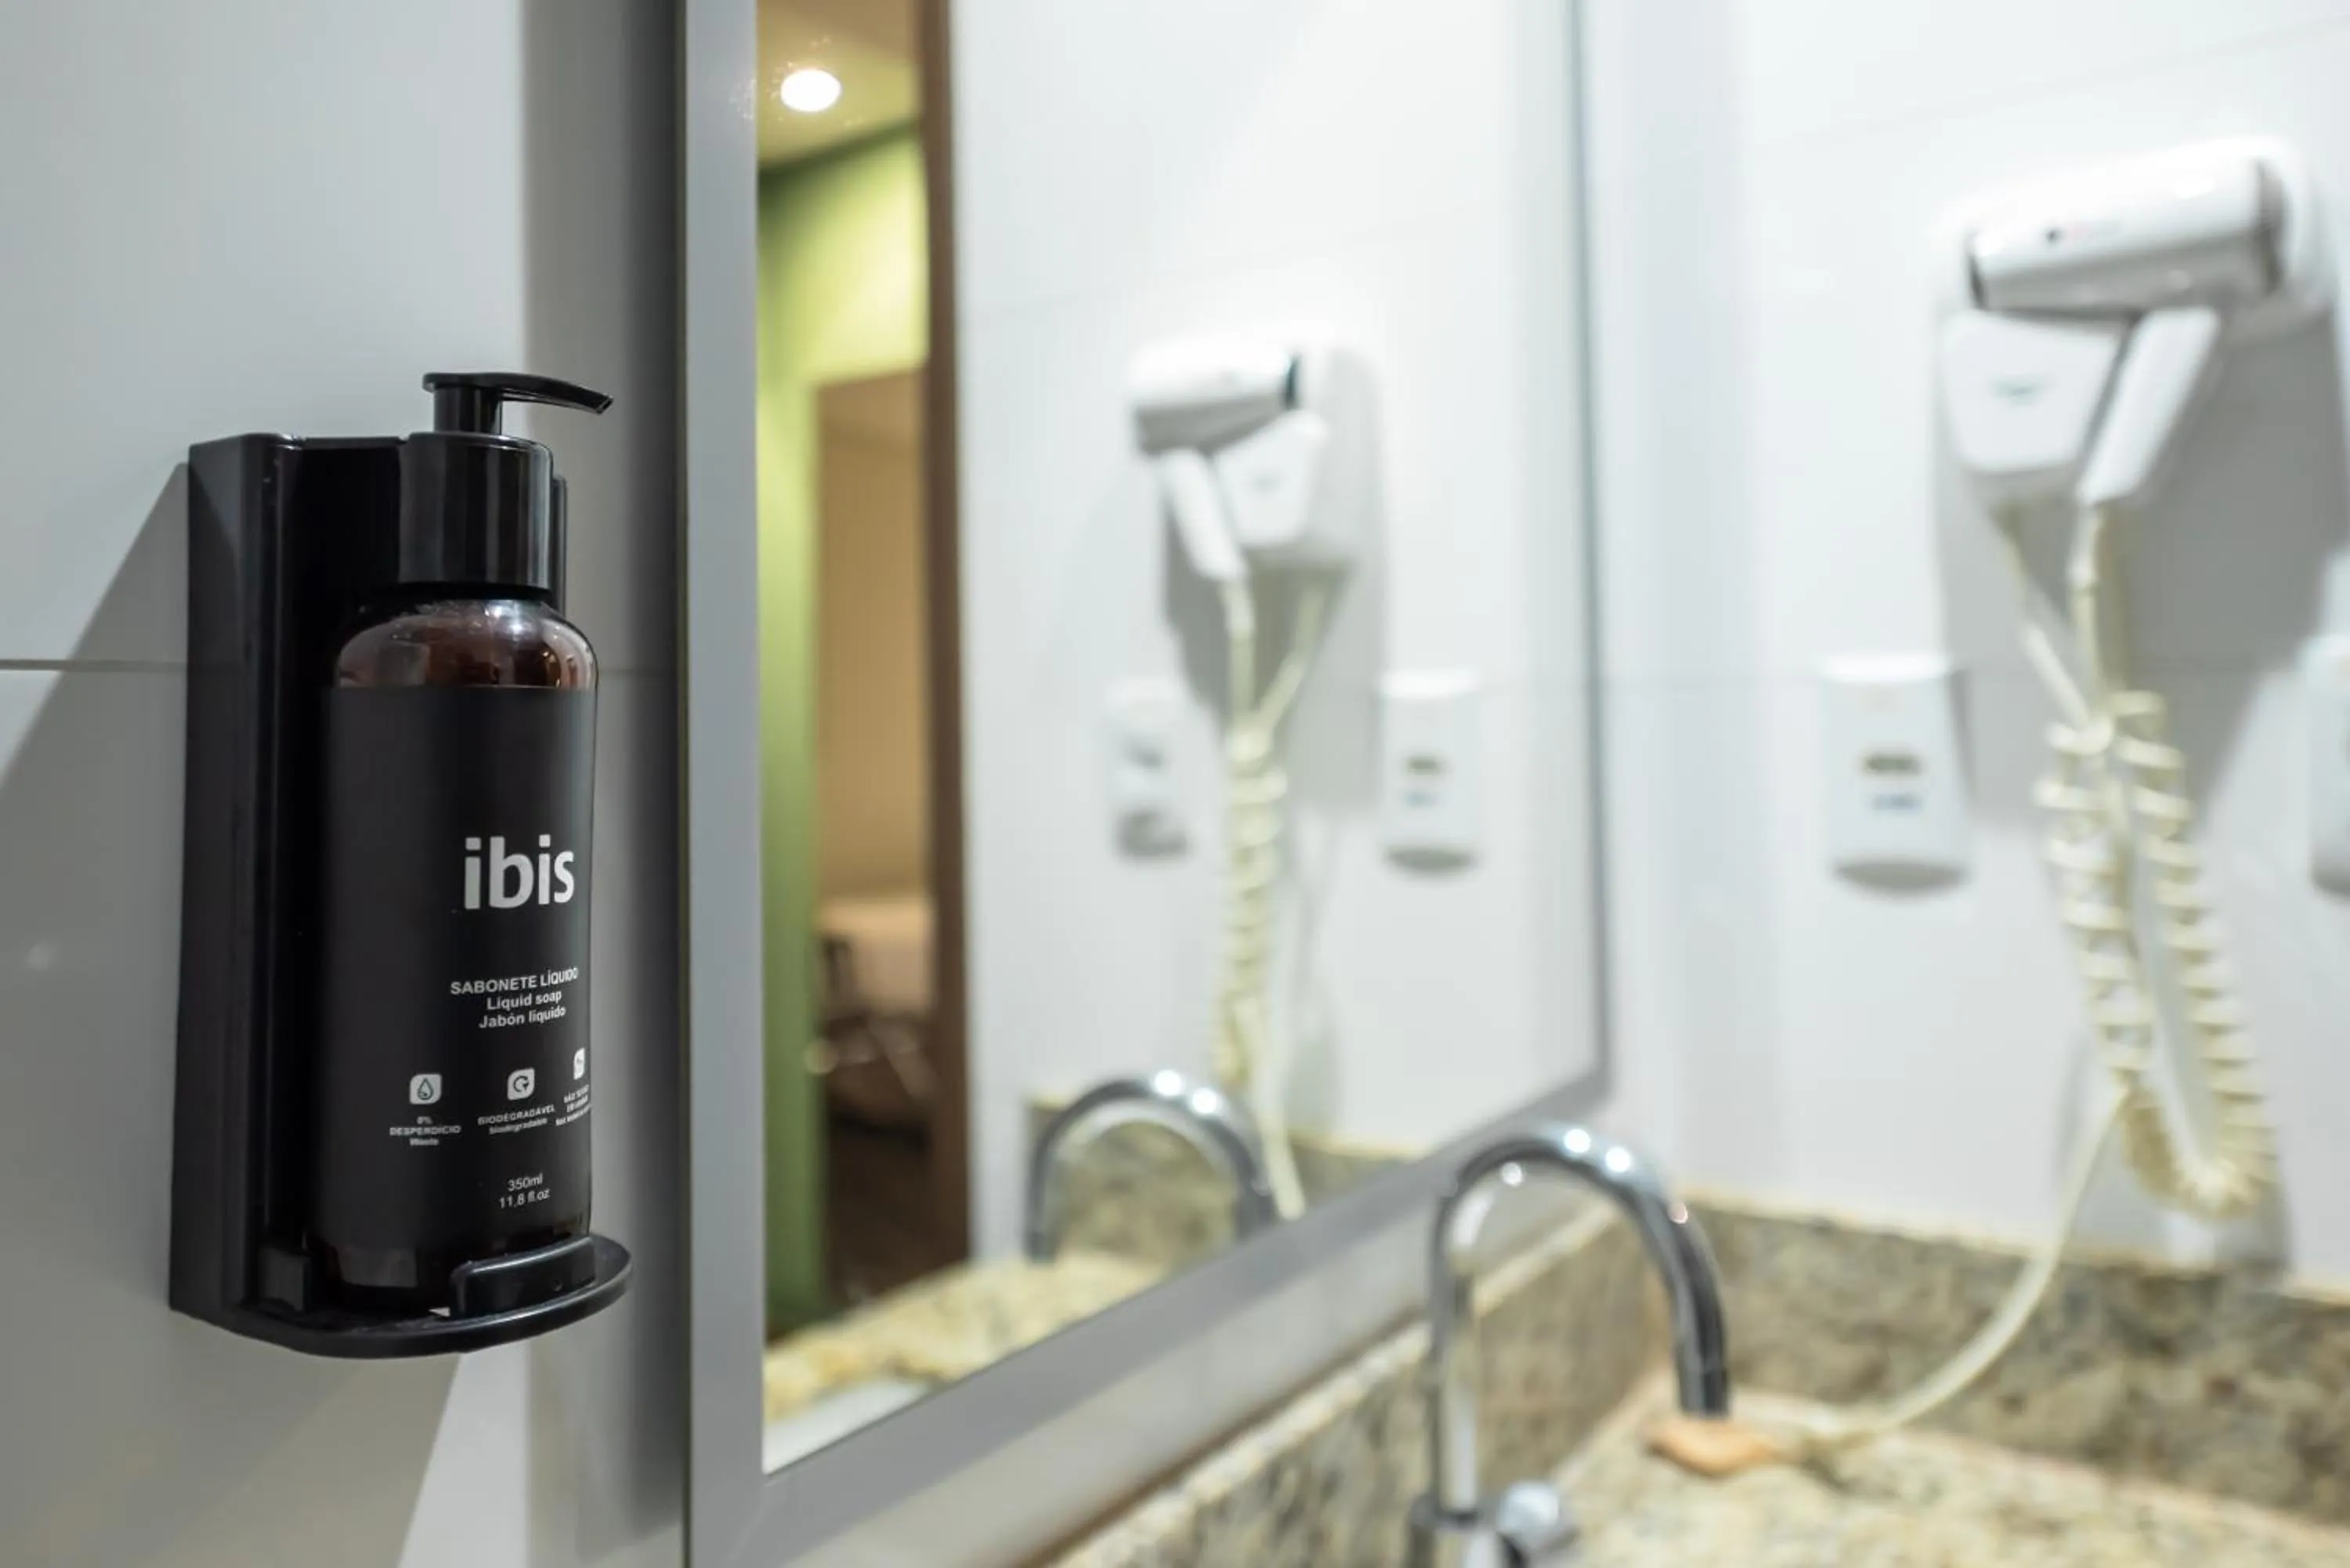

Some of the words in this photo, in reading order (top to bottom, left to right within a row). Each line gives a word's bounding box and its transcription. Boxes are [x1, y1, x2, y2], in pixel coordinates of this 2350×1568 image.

[465, 833, 574, 909] ibis
[450, 975, 537, 995] SABONETE
[540, 966, 578, 986] LÍQUIDO
[486, 993, 532, 1010] Liquid
[535, 991, 562, 1005] soap
[479, 1013, 525, 1028] Jabón
[507, 1172, 543, 1191] 350ml
